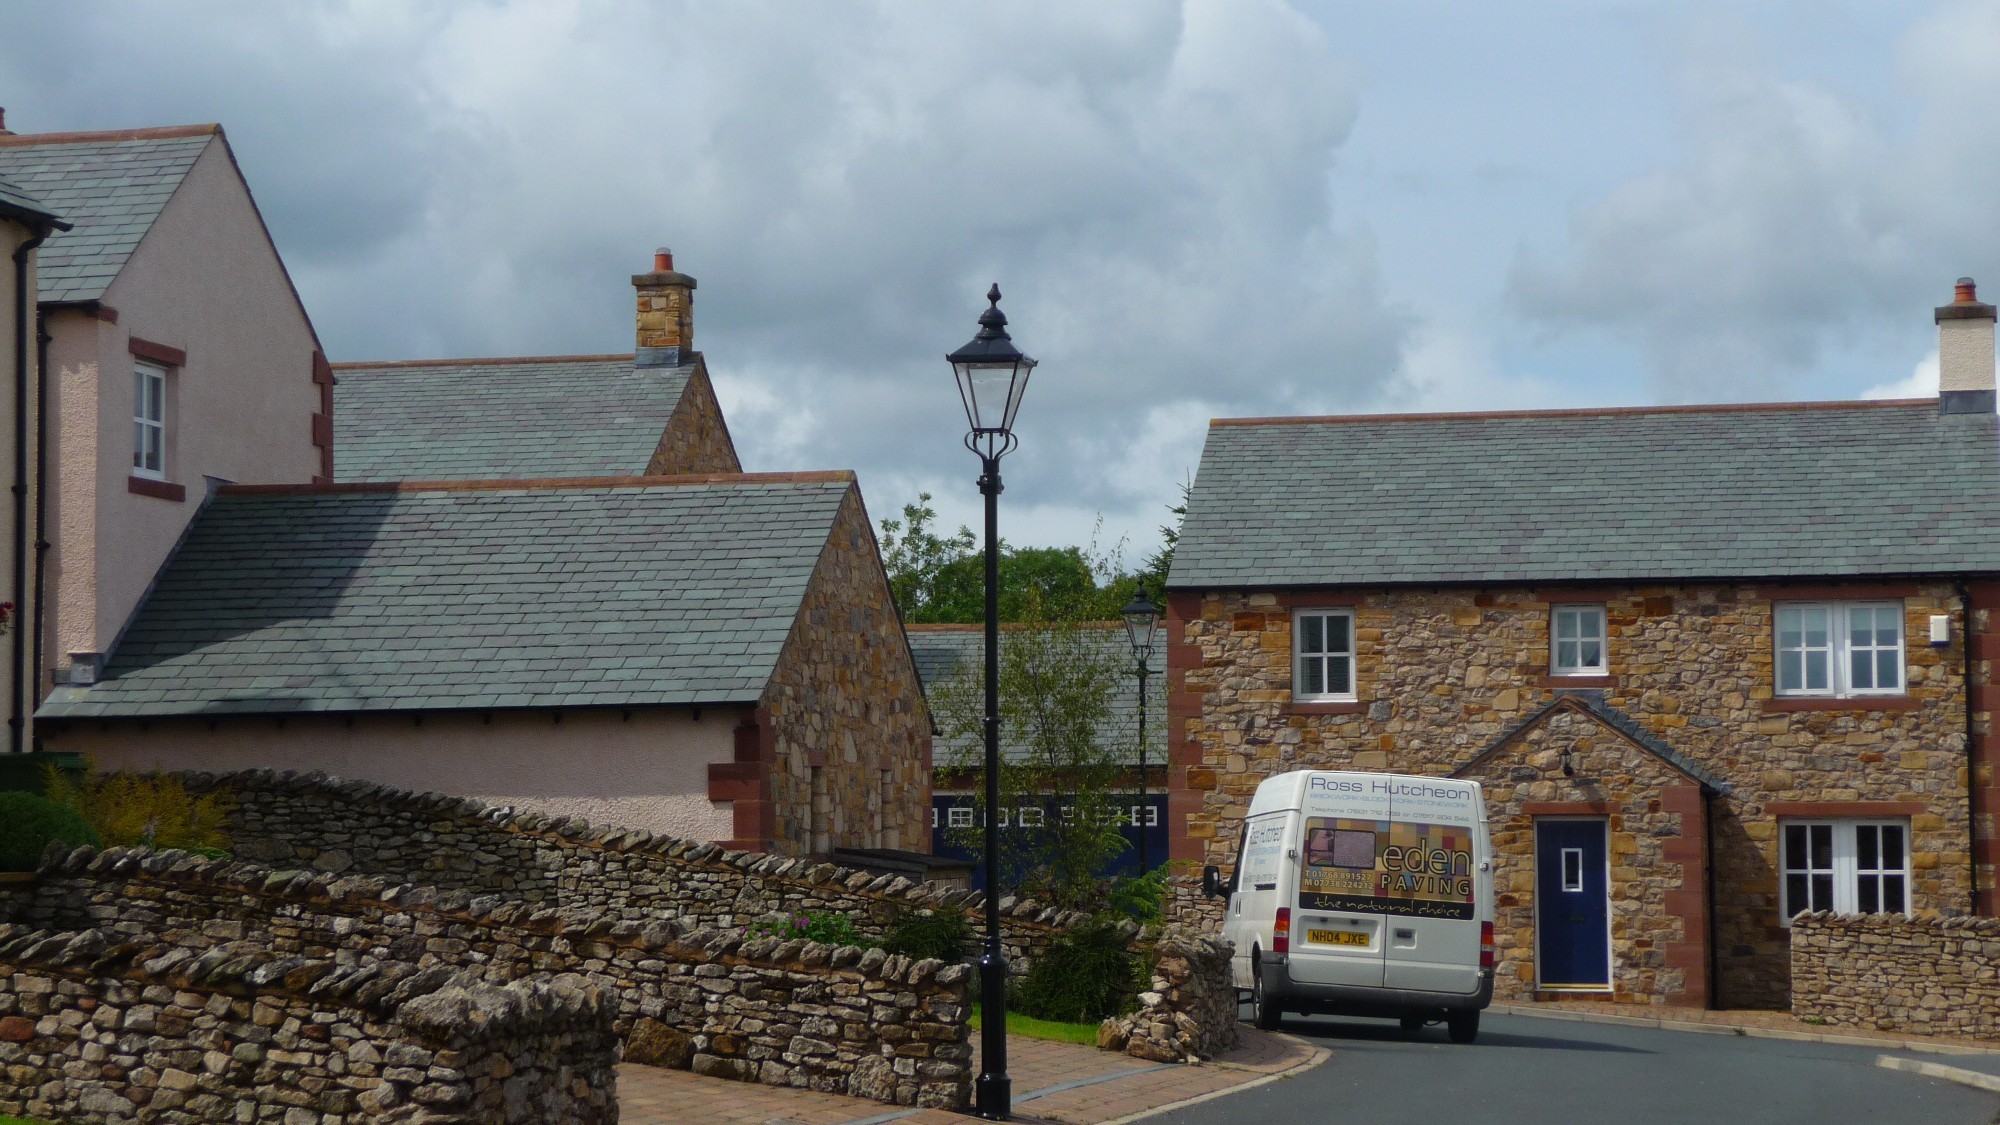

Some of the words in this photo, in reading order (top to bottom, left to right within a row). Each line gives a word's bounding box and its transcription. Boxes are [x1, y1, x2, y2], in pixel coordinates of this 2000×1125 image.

[1311, 777, 1363, 792] Ross
[1371, 780, 1470, 800] Hutcheon
[1382, 838, 1471, 876] eden
[1312, 871, 1338, 879] 01768
[1314, 879, 1341, 888] 07738
[1380, 873, 1471, 896] PAVING
[1315, 895, 1341, 909] the
[1346, 900, 1414, 913] natural
[1418, 902, 1461, 917] choice
[1312, 931, 1341, 943] NH04
[1344, 933, 1366, 945] JXE
